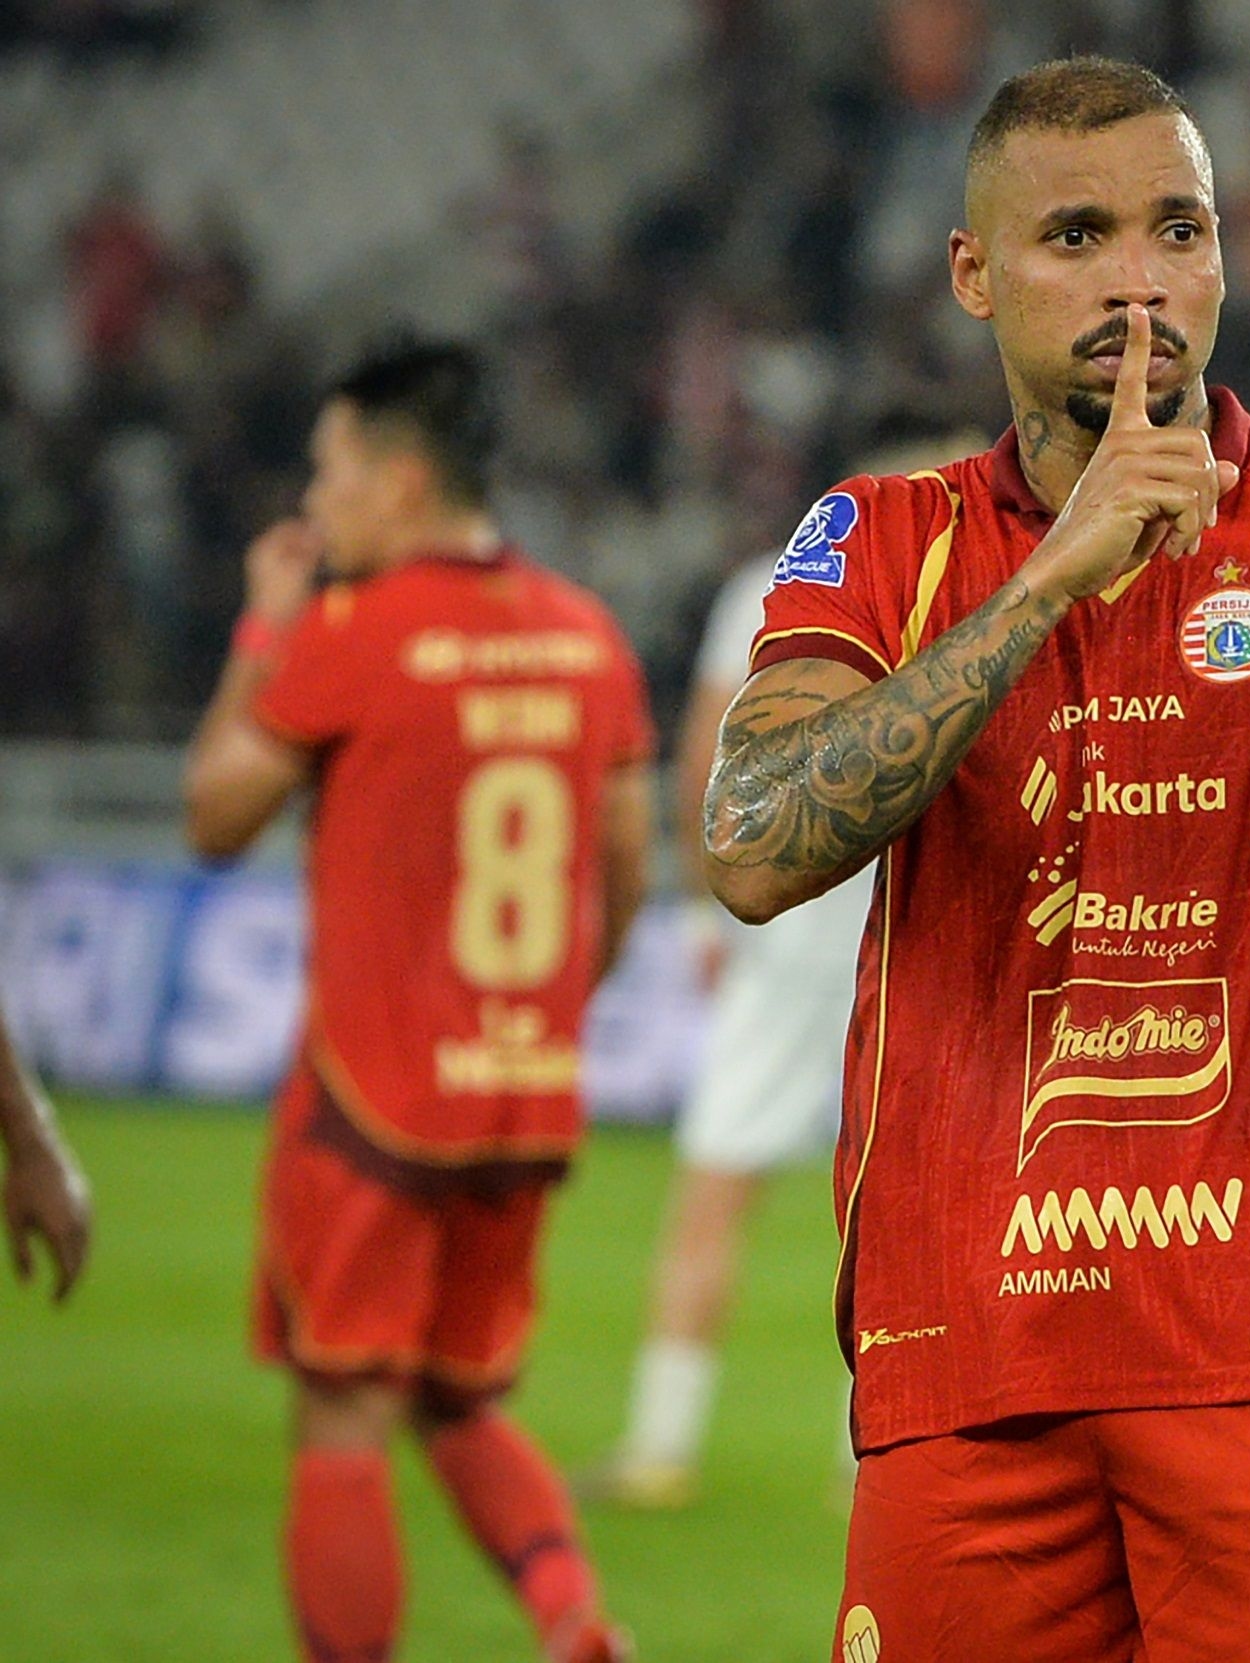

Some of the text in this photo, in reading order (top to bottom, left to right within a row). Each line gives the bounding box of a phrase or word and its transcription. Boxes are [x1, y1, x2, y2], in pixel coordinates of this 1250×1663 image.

[1107, 695, 1185, 722] JAYA
[450, 755, 574, 992] 8
[1073, 890, 1218, 931] Bakrie
[998, 1267, 1111, 1297] AMMAN
